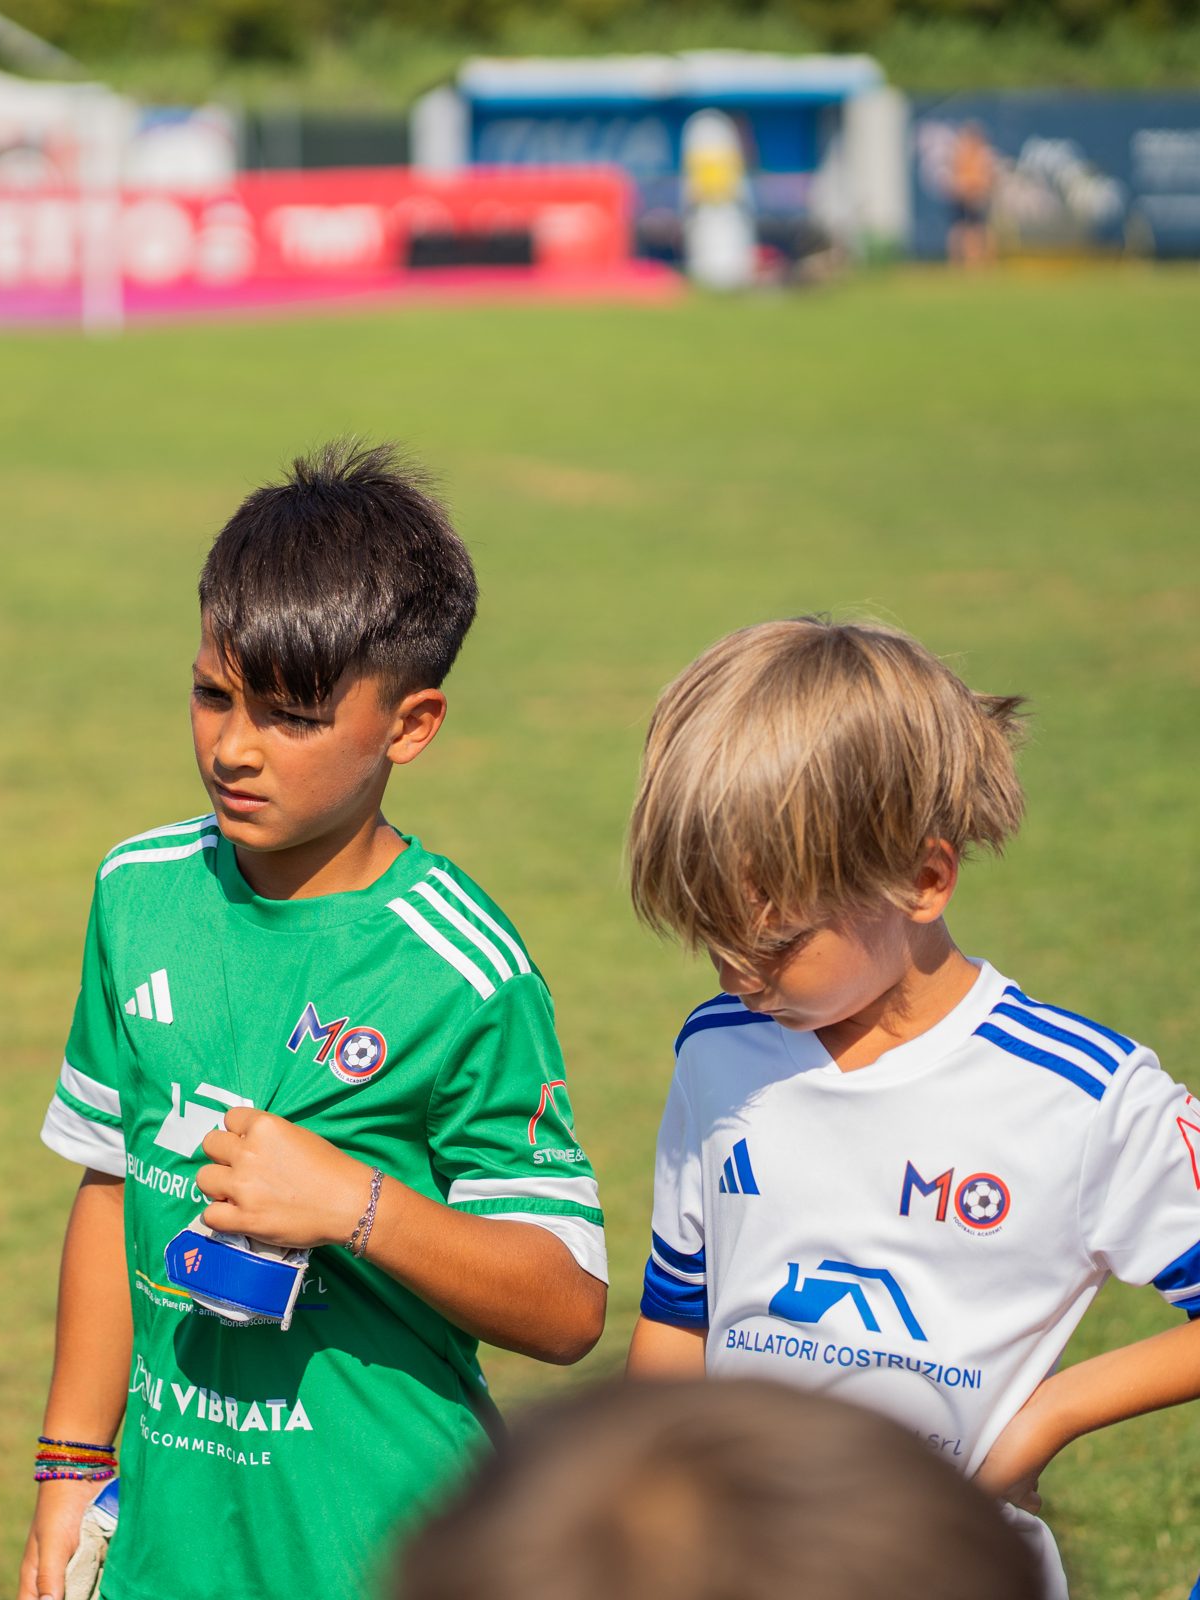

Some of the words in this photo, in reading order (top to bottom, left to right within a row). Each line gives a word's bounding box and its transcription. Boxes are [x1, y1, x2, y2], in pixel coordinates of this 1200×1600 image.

[726, 1328, 819, 1362] BALLATORI
[823, 1343, 982, 1390] COSTRUZIONI
[170, 1382, 314, 1432] VIBRATA
[150, 1430, 271, 1466] COMMERCIALE
